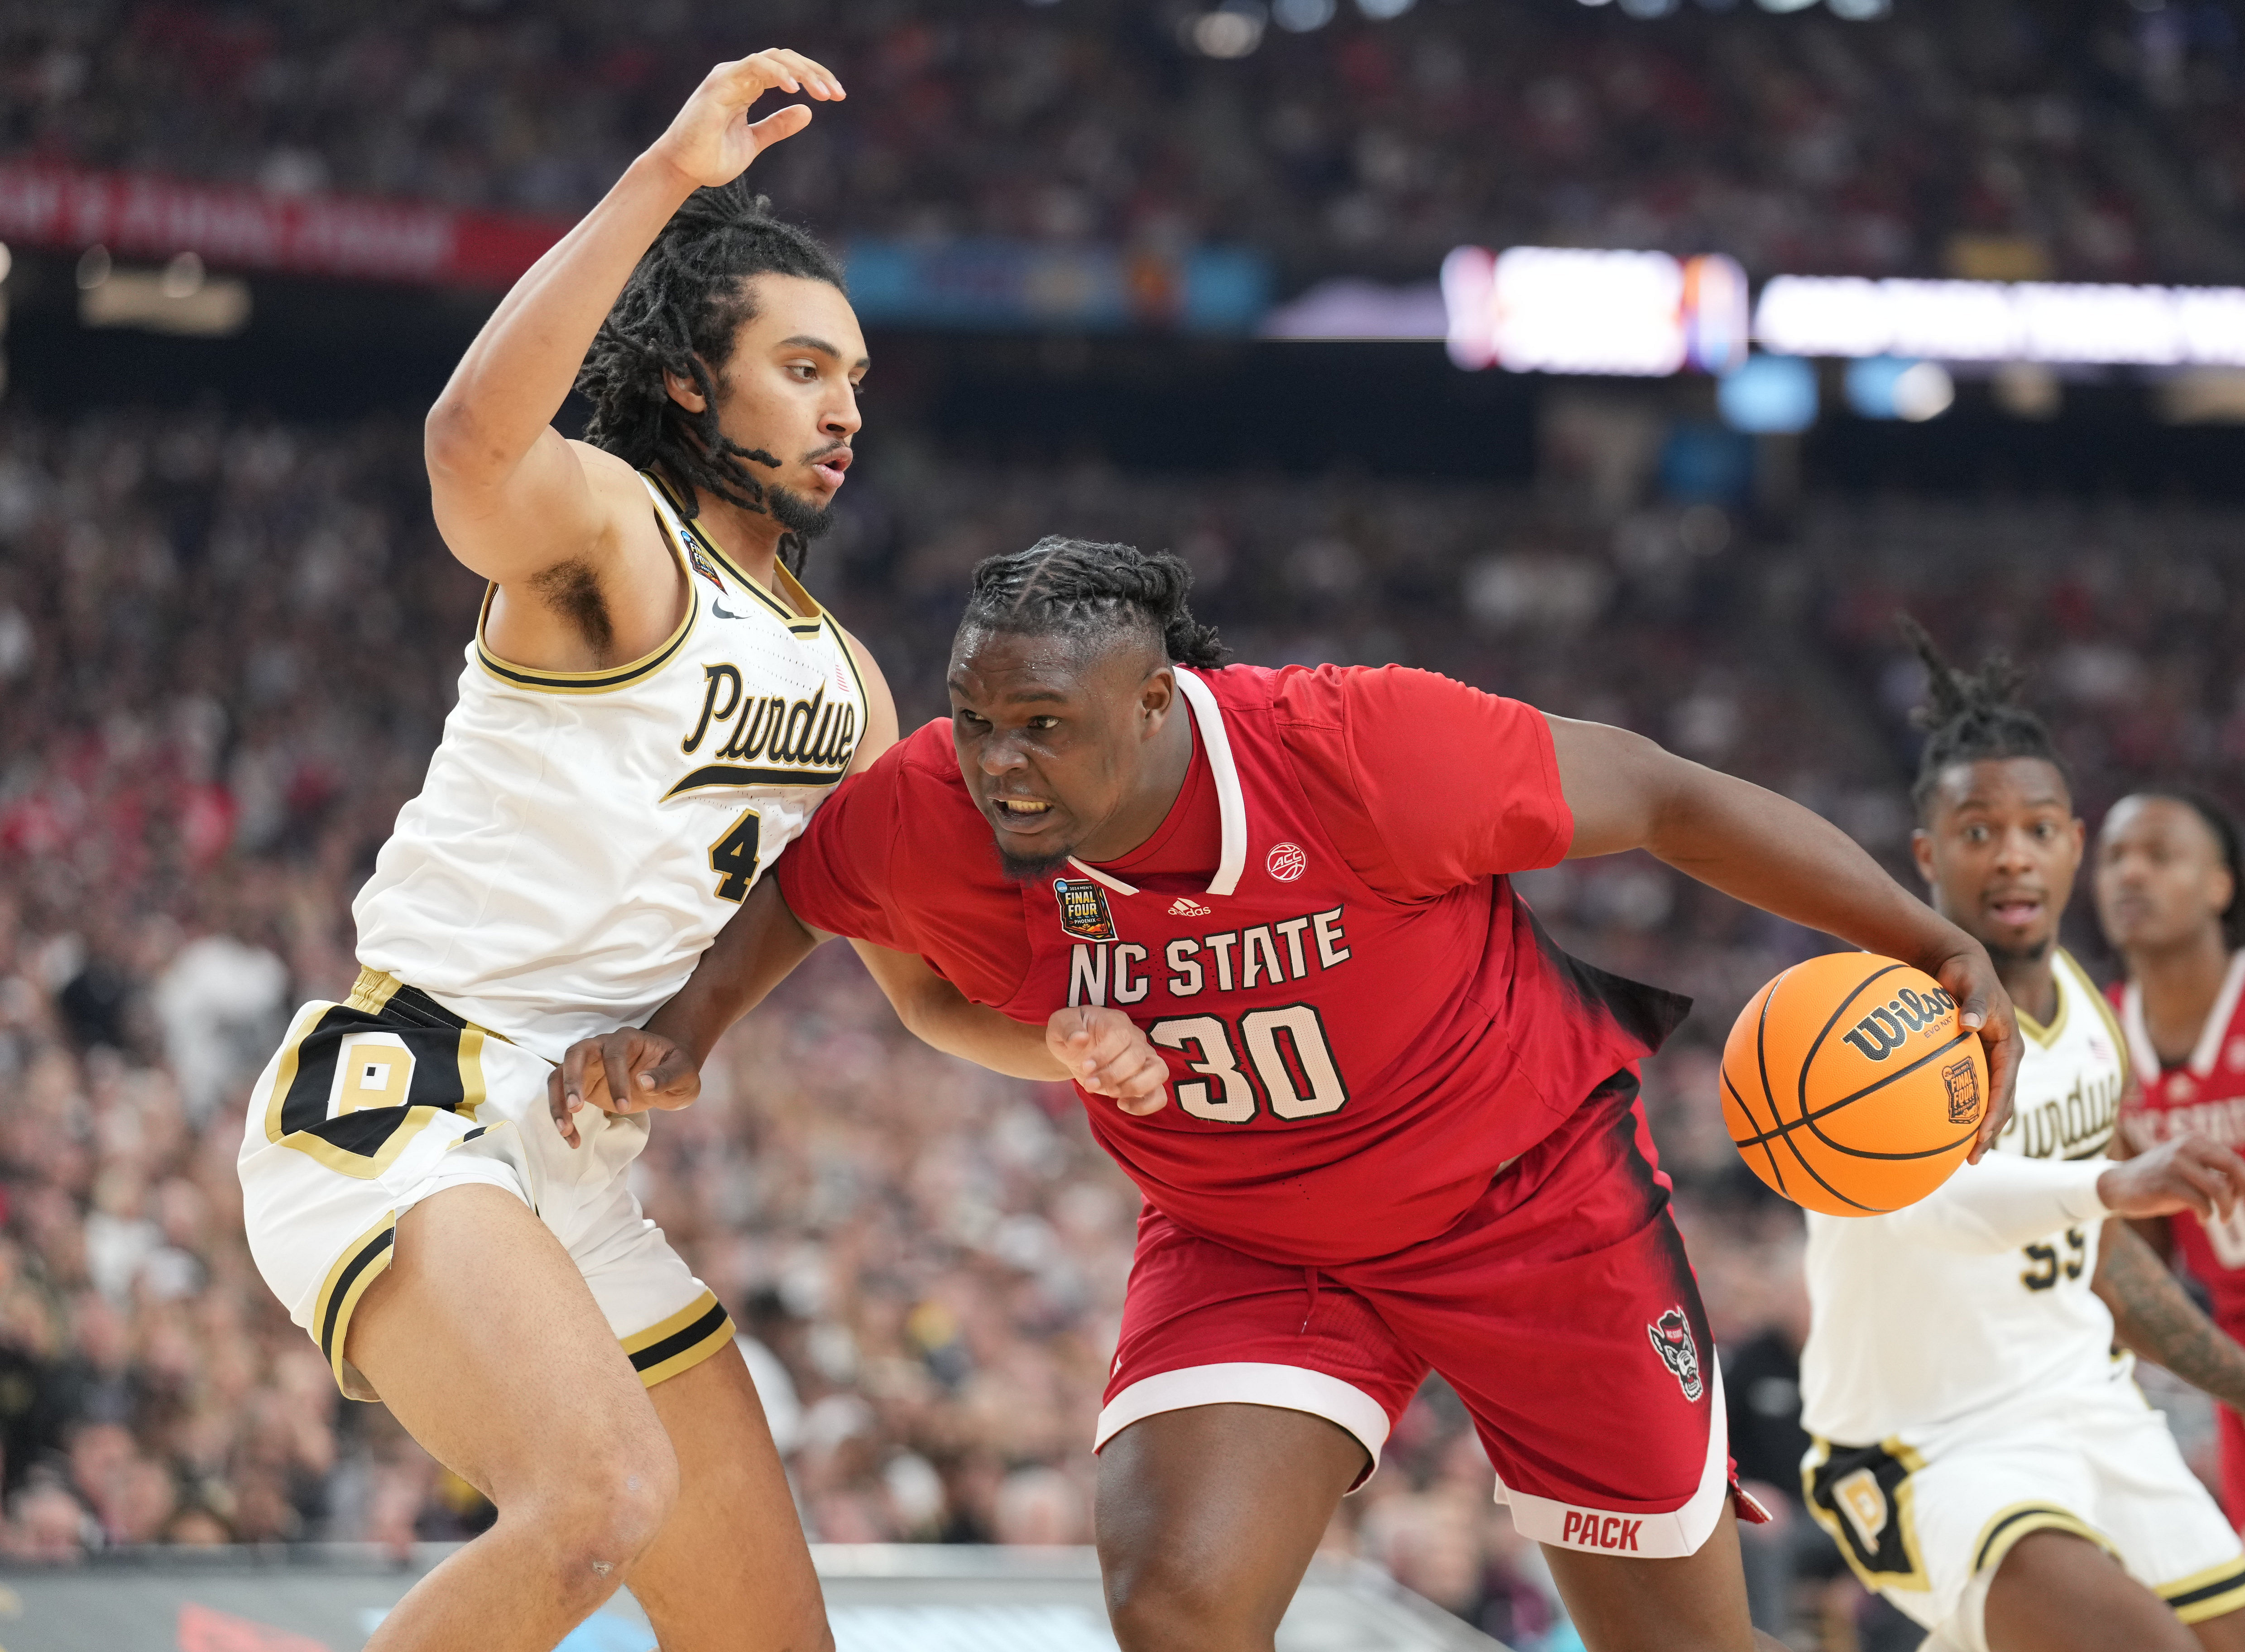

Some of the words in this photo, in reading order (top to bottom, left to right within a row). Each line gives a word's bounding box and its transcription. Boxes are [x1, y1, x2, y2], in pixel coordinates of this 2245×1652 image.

[681, 663, 855, 768] Purdue
[708, 808, 761, 904] 4
[1272, 849, 1302, 869] ACC
[1065, 891, 1096, 905] FINAL
[1068, 903, 1098, 917] FOUR
[1067, 941, 1151, 1008] NC
[1166, 903, 1352, 997] STATE
[1842, 986, 1961, 1061] Wilso
[1924, 1025, 1941, 1038] EVO
[1940, 1016, 1953, 1027] NXT
[1146, 1001, 1350, 1125] 30
[1951, 1069, 1973, 1093] FINAL
[1954, 1083, 1974, 1107] FOUR
[1563, 1511, 1643, 1551] PACK
